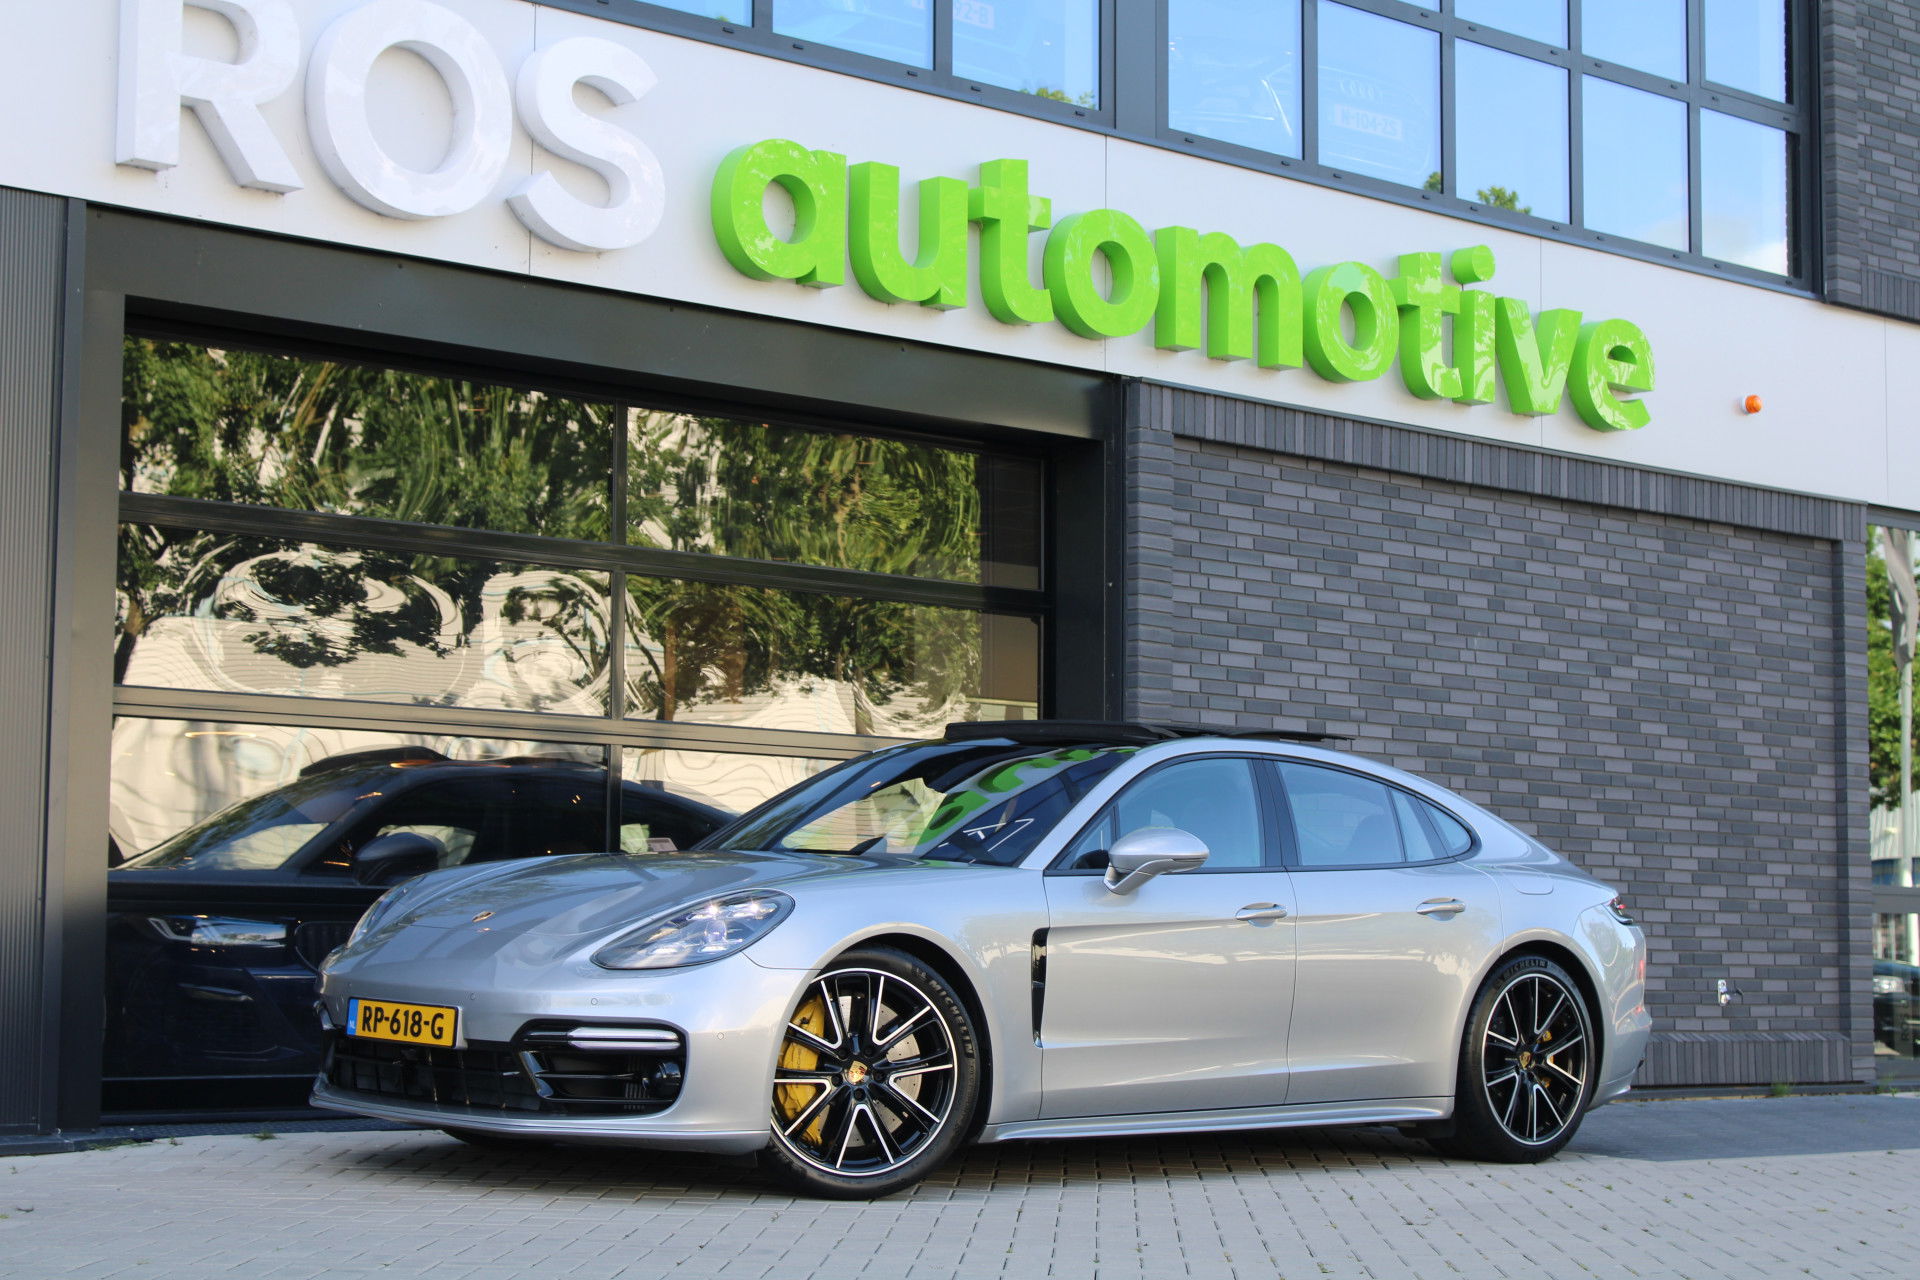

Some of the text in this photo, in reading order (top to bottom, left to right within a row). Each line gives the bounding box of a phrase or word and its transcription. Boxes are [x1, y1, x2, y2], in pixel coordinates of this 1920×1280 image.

[115, 0, 1655, 432] ROS automotive
[1503, 959, 1547, 979] MICHELIN
[362, 1005, 445, 1040] RP-618-G
[928, 979, 975, 1059] MICHELIN
